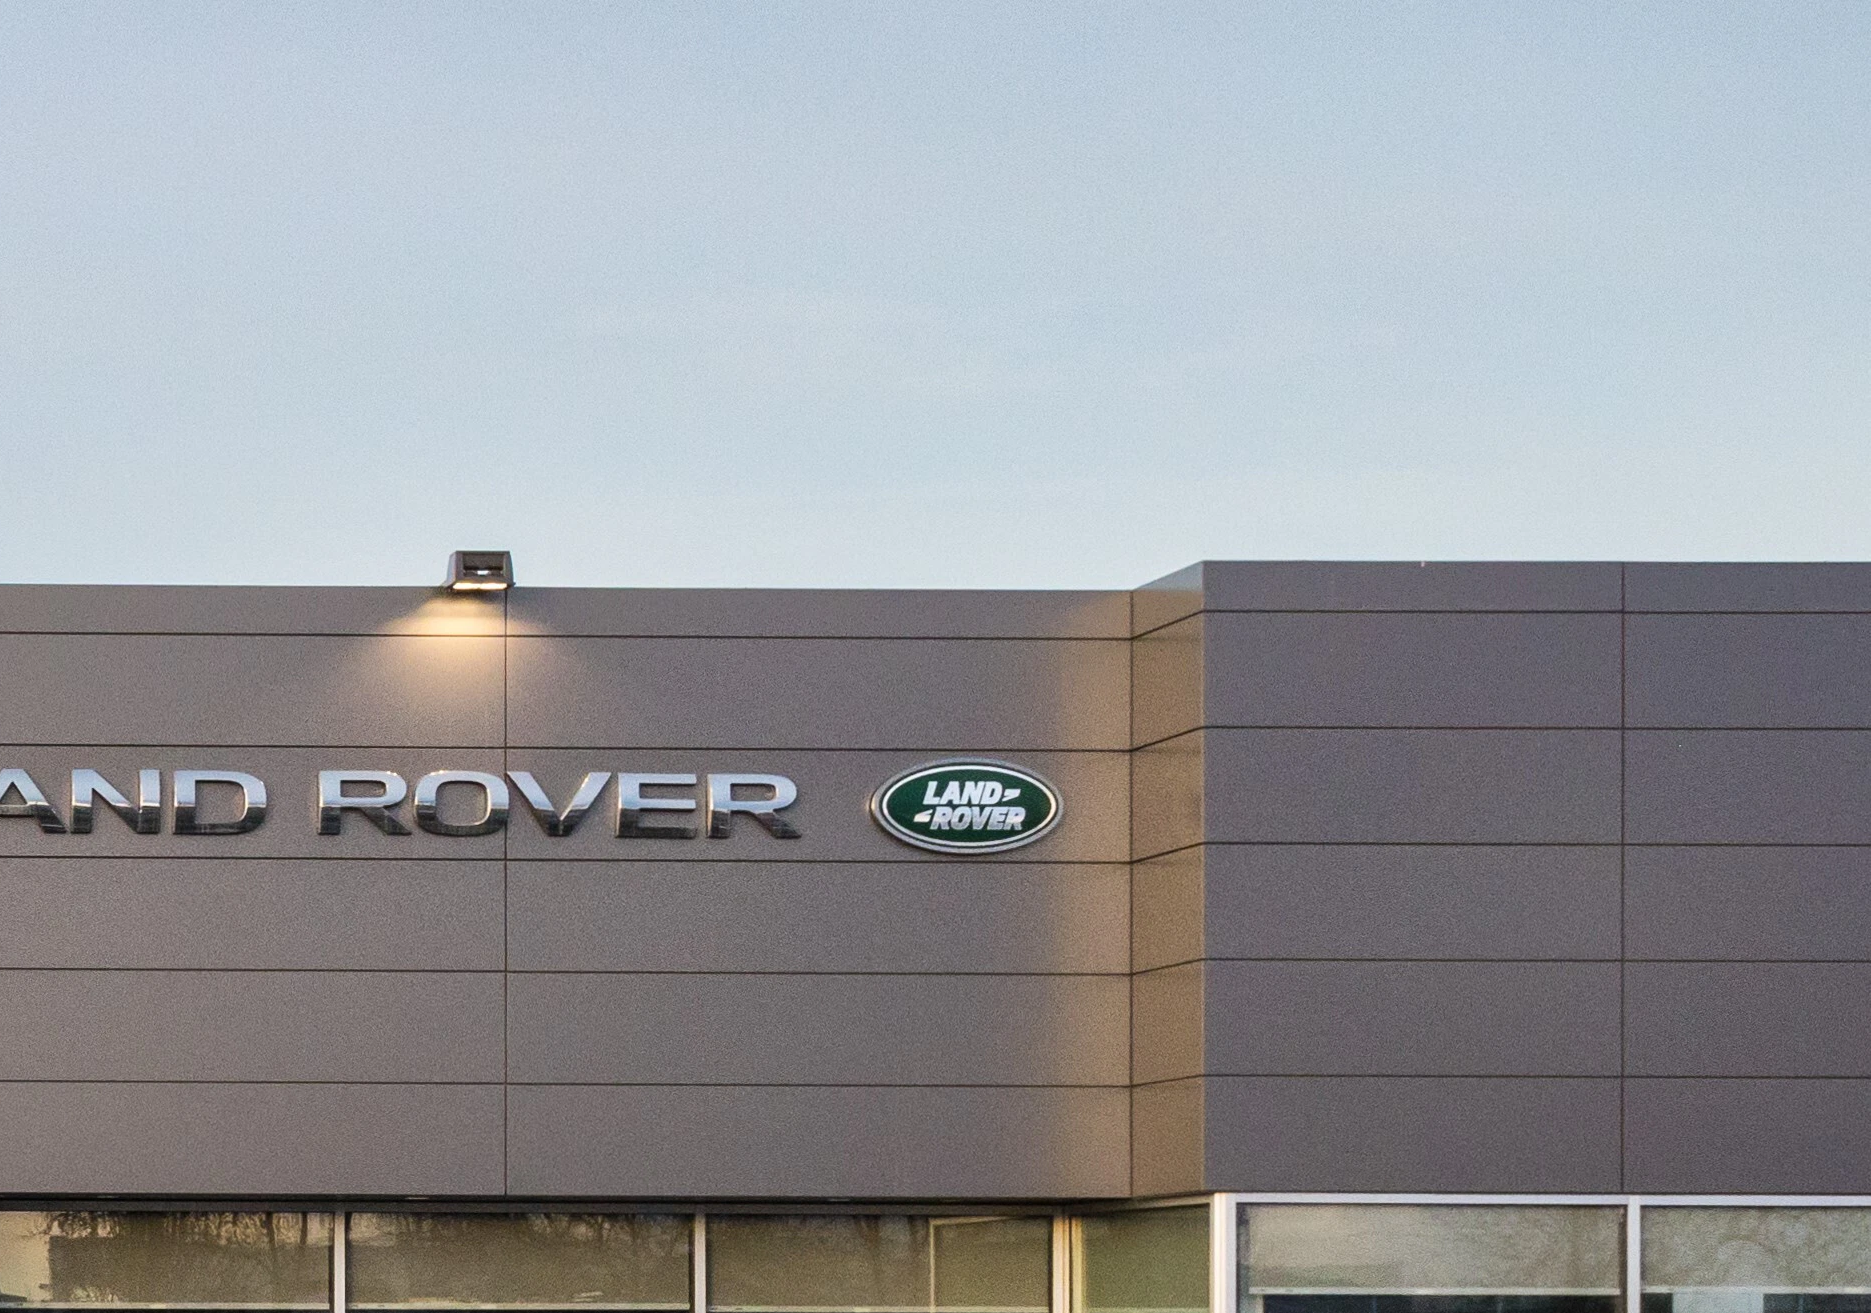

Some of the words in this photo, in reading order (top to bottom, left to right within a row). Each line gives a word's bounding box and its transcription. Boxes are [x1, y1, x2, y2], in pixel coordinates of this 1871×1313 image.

[316, 768, 803, 840] ROVER
[922, 781, 1003, 805] LAND
[930, 806, 1026, 830] ROVER
